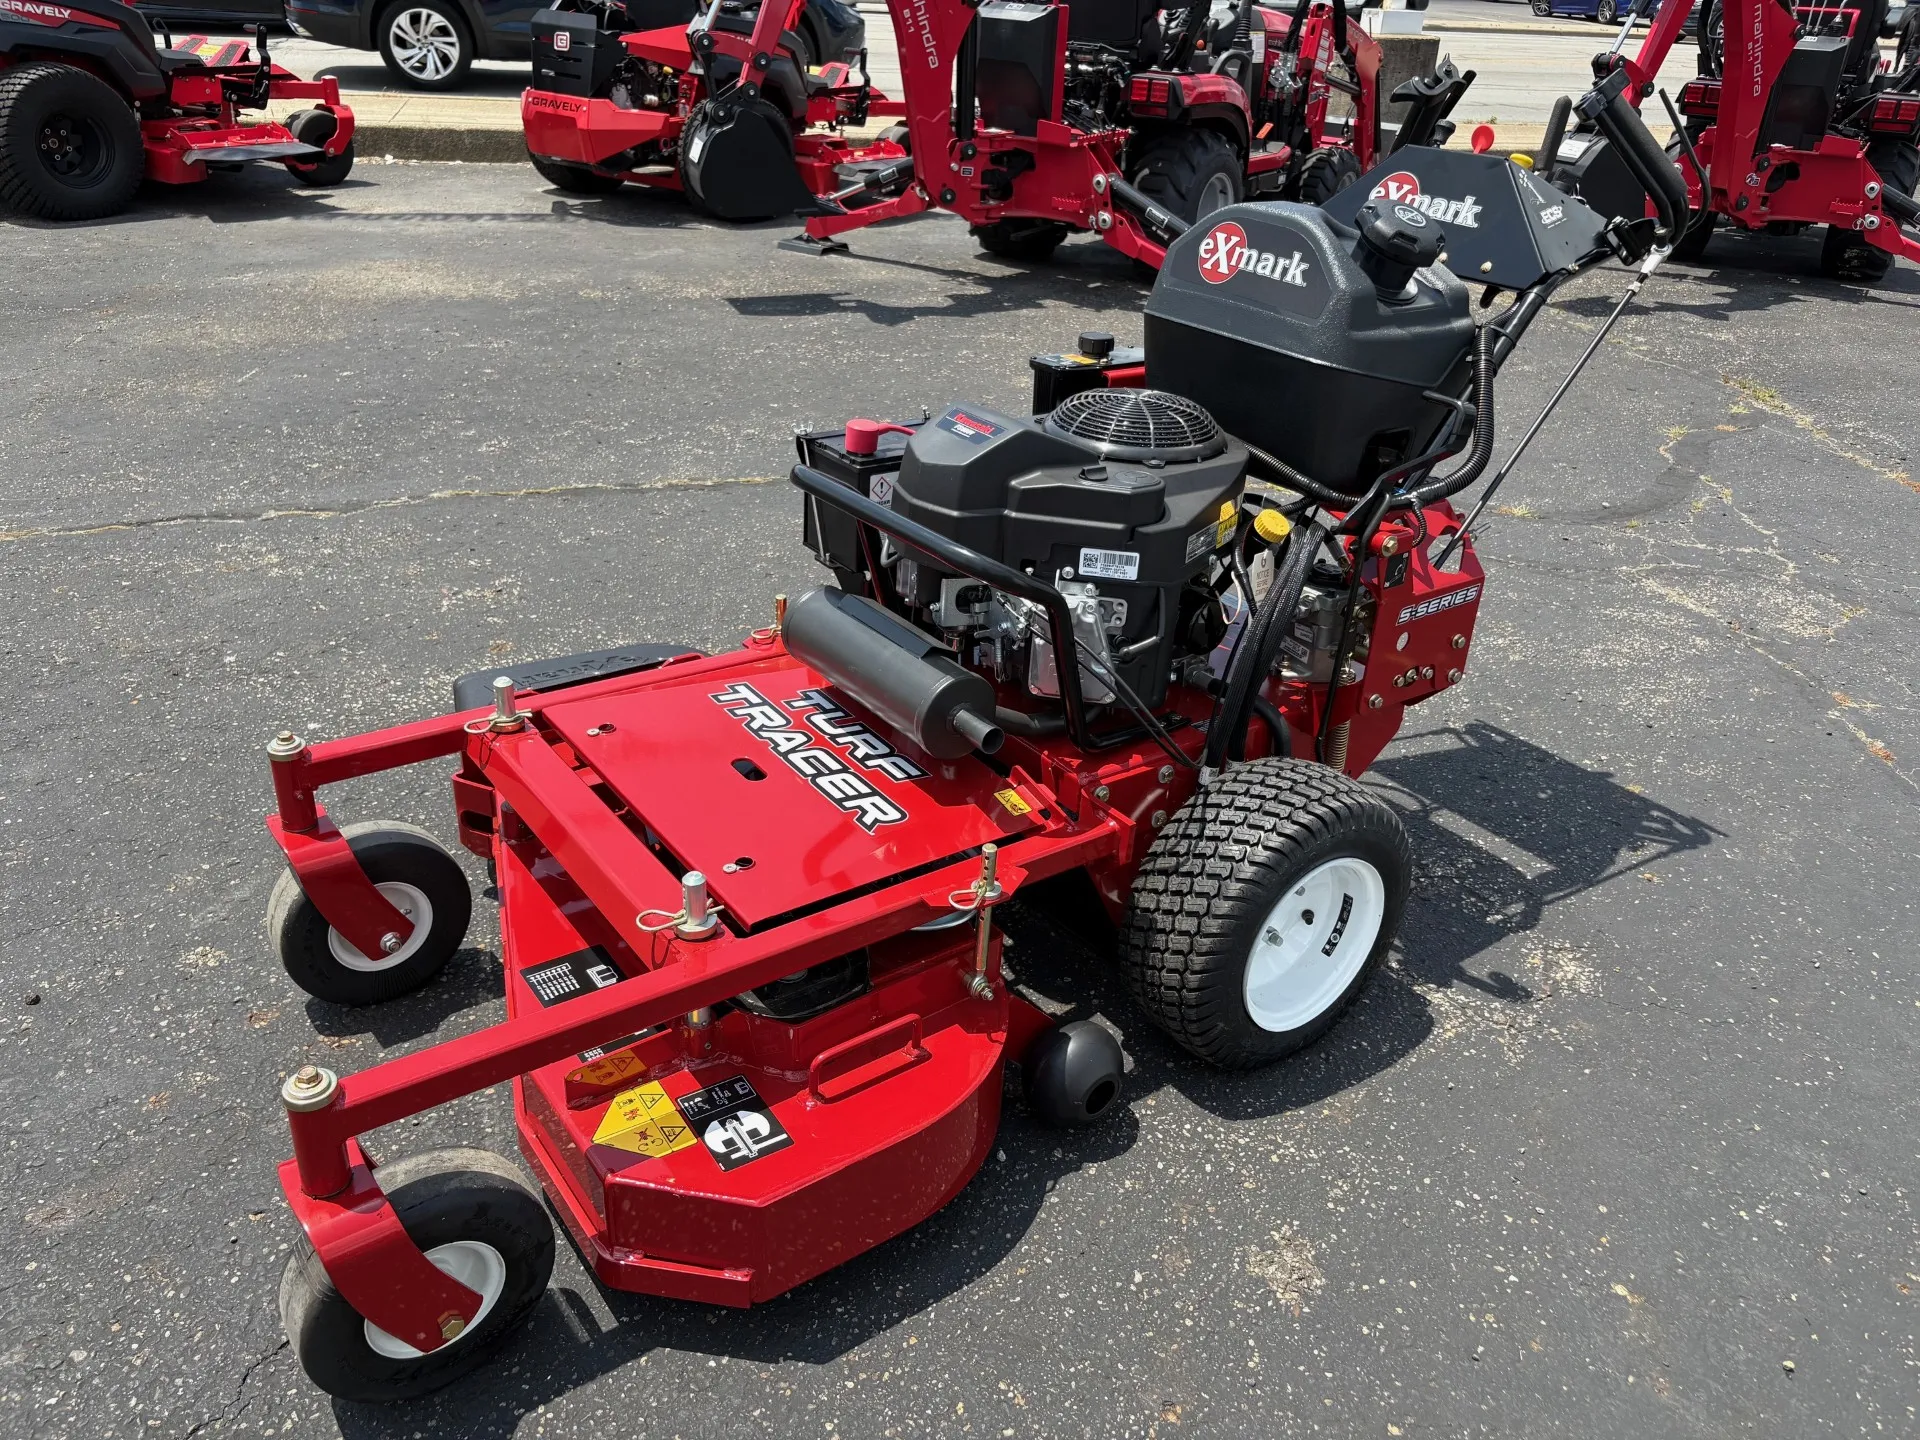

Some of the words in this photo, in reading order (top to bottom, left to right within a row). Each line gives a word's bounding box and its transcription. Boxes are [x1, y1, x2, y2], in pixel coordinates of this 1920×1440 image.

[0, 0, 71, 18] GRAVELY
[1754, 3, 1764, 97] mahindra
[532, 97, 581, 112] GRAVELY
[1397, 586, 1479, 624] S-SERIES
[713, 684, 906, 830] TRACER
[787, 690, 928, 780] TURF
